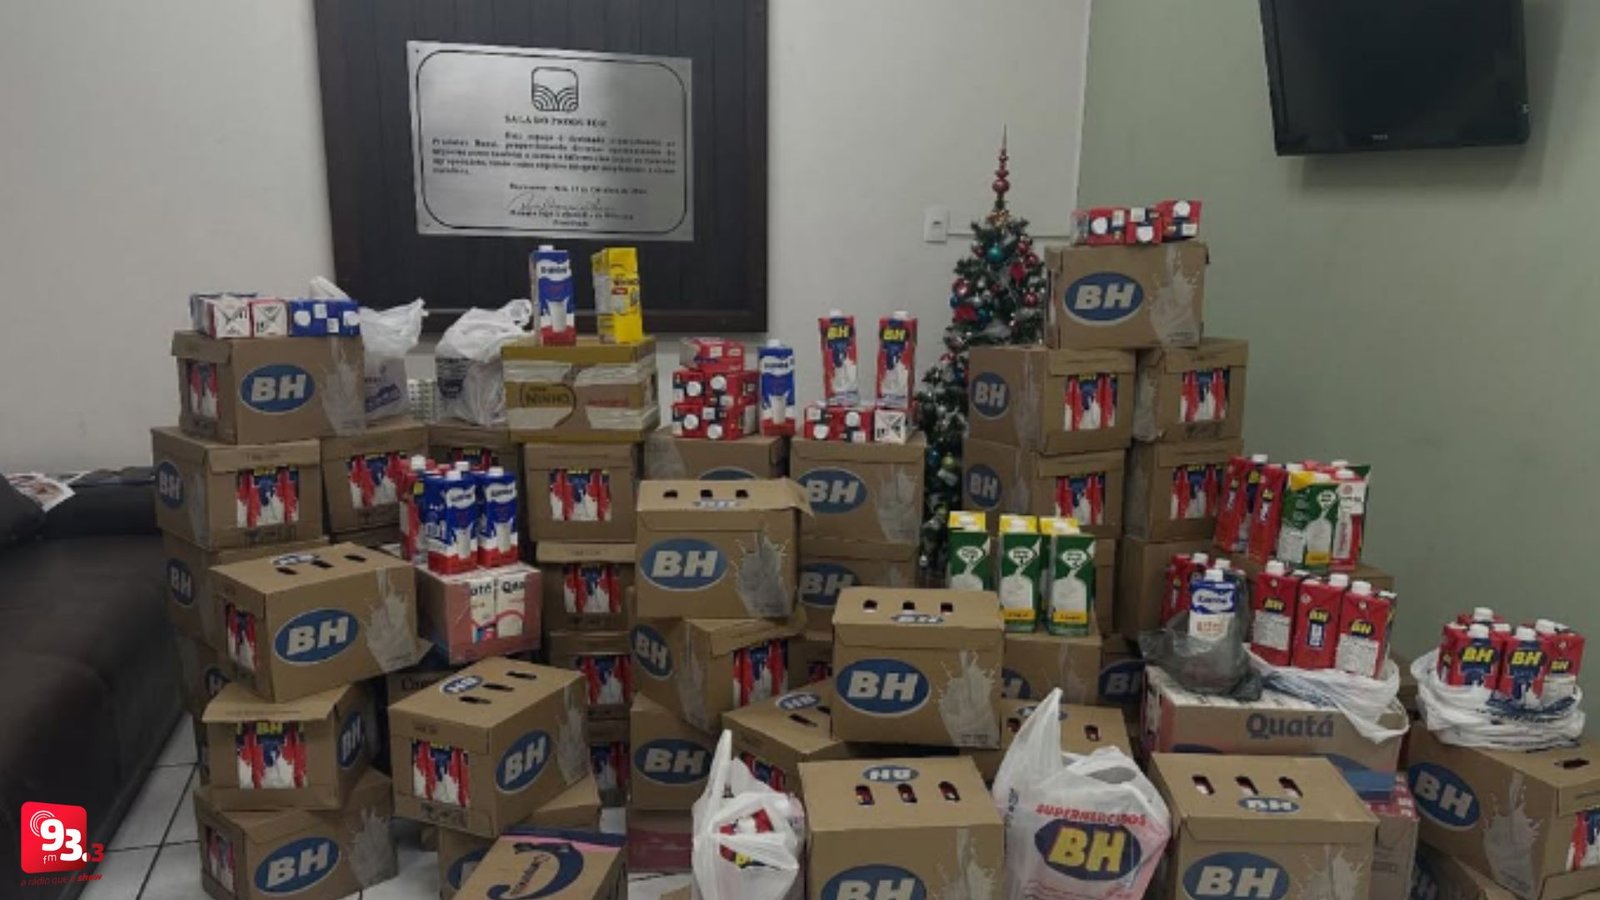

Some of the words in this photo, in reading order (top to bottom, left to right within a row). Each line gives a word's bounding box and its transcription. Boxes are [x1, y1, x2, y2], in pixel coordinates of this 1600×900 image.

[1074, 283, 1136, 310] BH
[827, 325, 850, 340] BH
[251, 374, 306, 402] BH
[973, 382, 1008, 407] BH
[158, 474, 181, 501] BH
[806, 480, 860, 503] BH
[969, 472, 998, 499] BH
[651, 551, 718, 577] BH
[170, 569, 192, 598] BH
[802, 572, 854, 596] BH
[286, 616, 349, 656] BH
[634, 630, 669, 671] BH
[1462, 646, 1494, 662] BH
[1511, 651, 1542, 666] BH
[847, 671, 918, 701] BH
[1246, 713, 1334, 739] Quatá
[504, 735, 547, 785] BH
[643, 749, 706, 773] BH
[1413, 769, 1474, 818] BH
[1047, 827, 1126, 873] BH
[266, 841, 331, 888] BH
[836, 878, 917, 900] BH
[1195, 865, 1281, 898] BH
